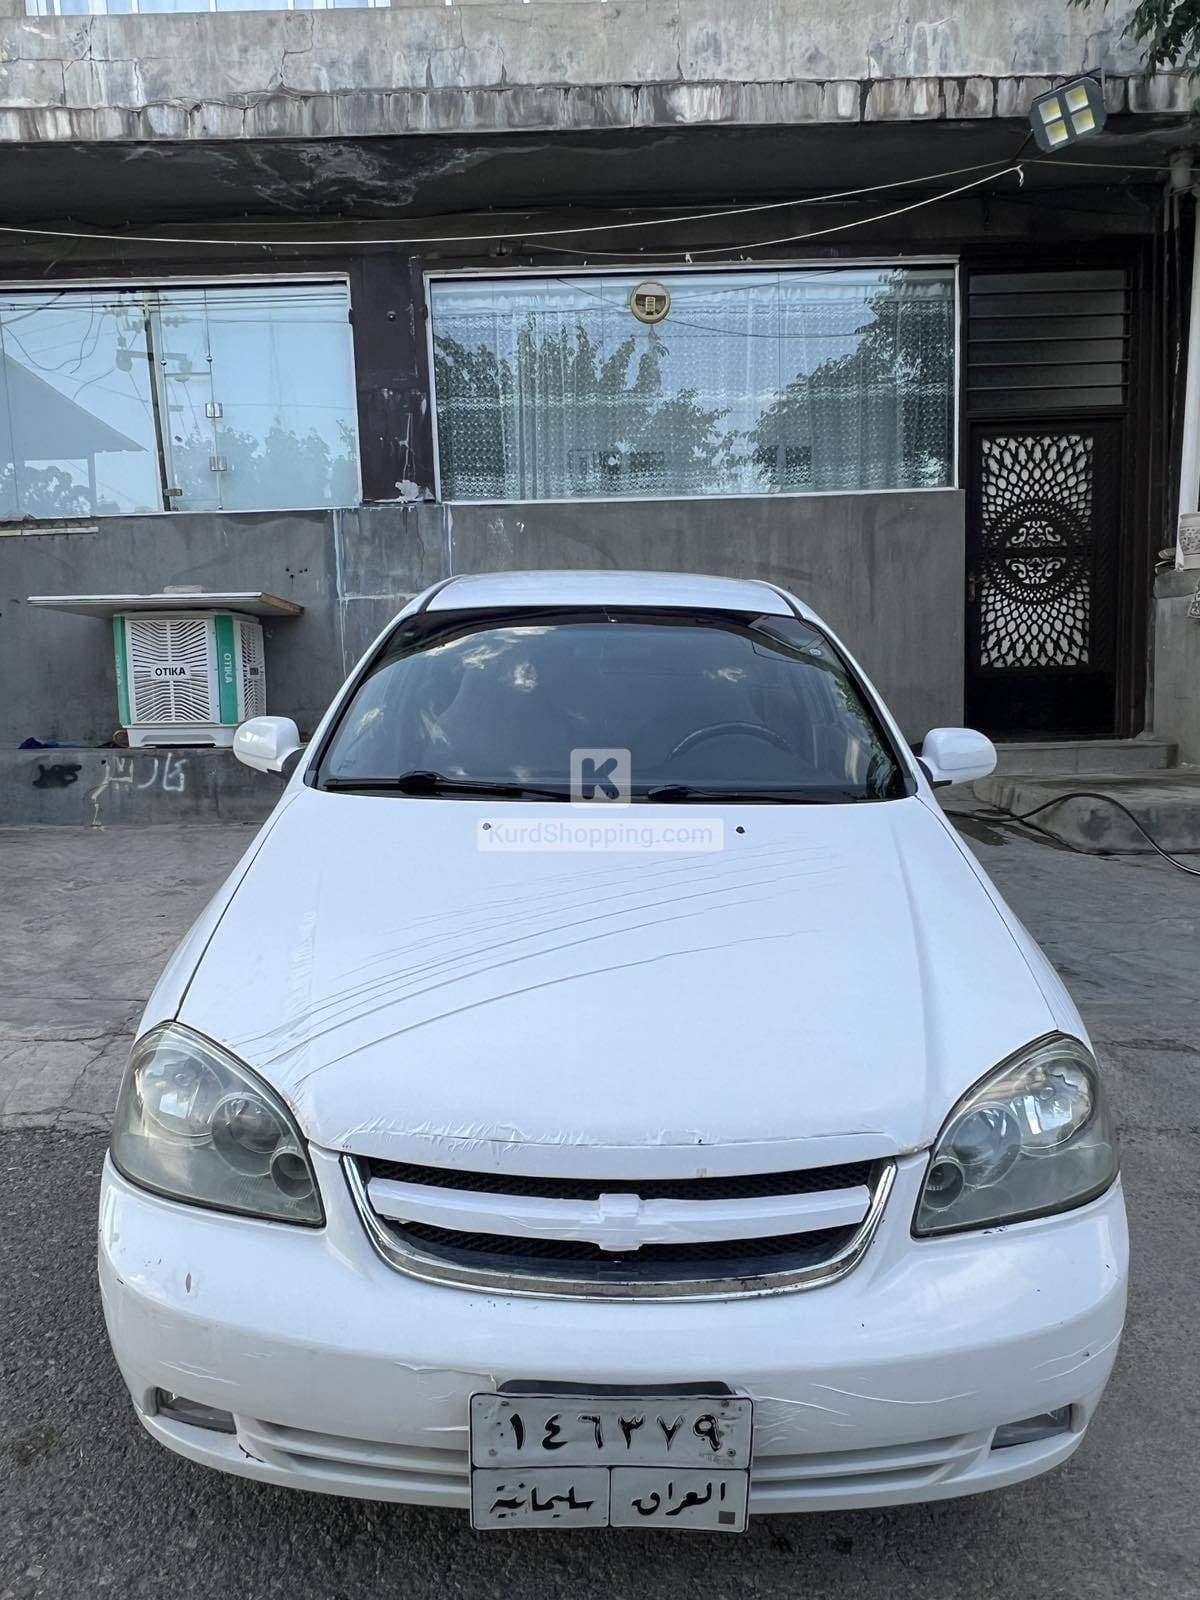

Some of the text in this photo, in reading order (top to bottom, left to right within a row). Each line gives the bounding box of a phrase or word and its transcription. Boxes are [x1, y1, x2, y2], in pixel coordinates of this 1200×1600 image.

[155, 667, 186, 676] OTIKA
[224, 652, 233, 684] OTIKA
[509, 1413, 721, 1452] ١٤٦٣٧٩
[631, 1482, 726, 1516] العراق
